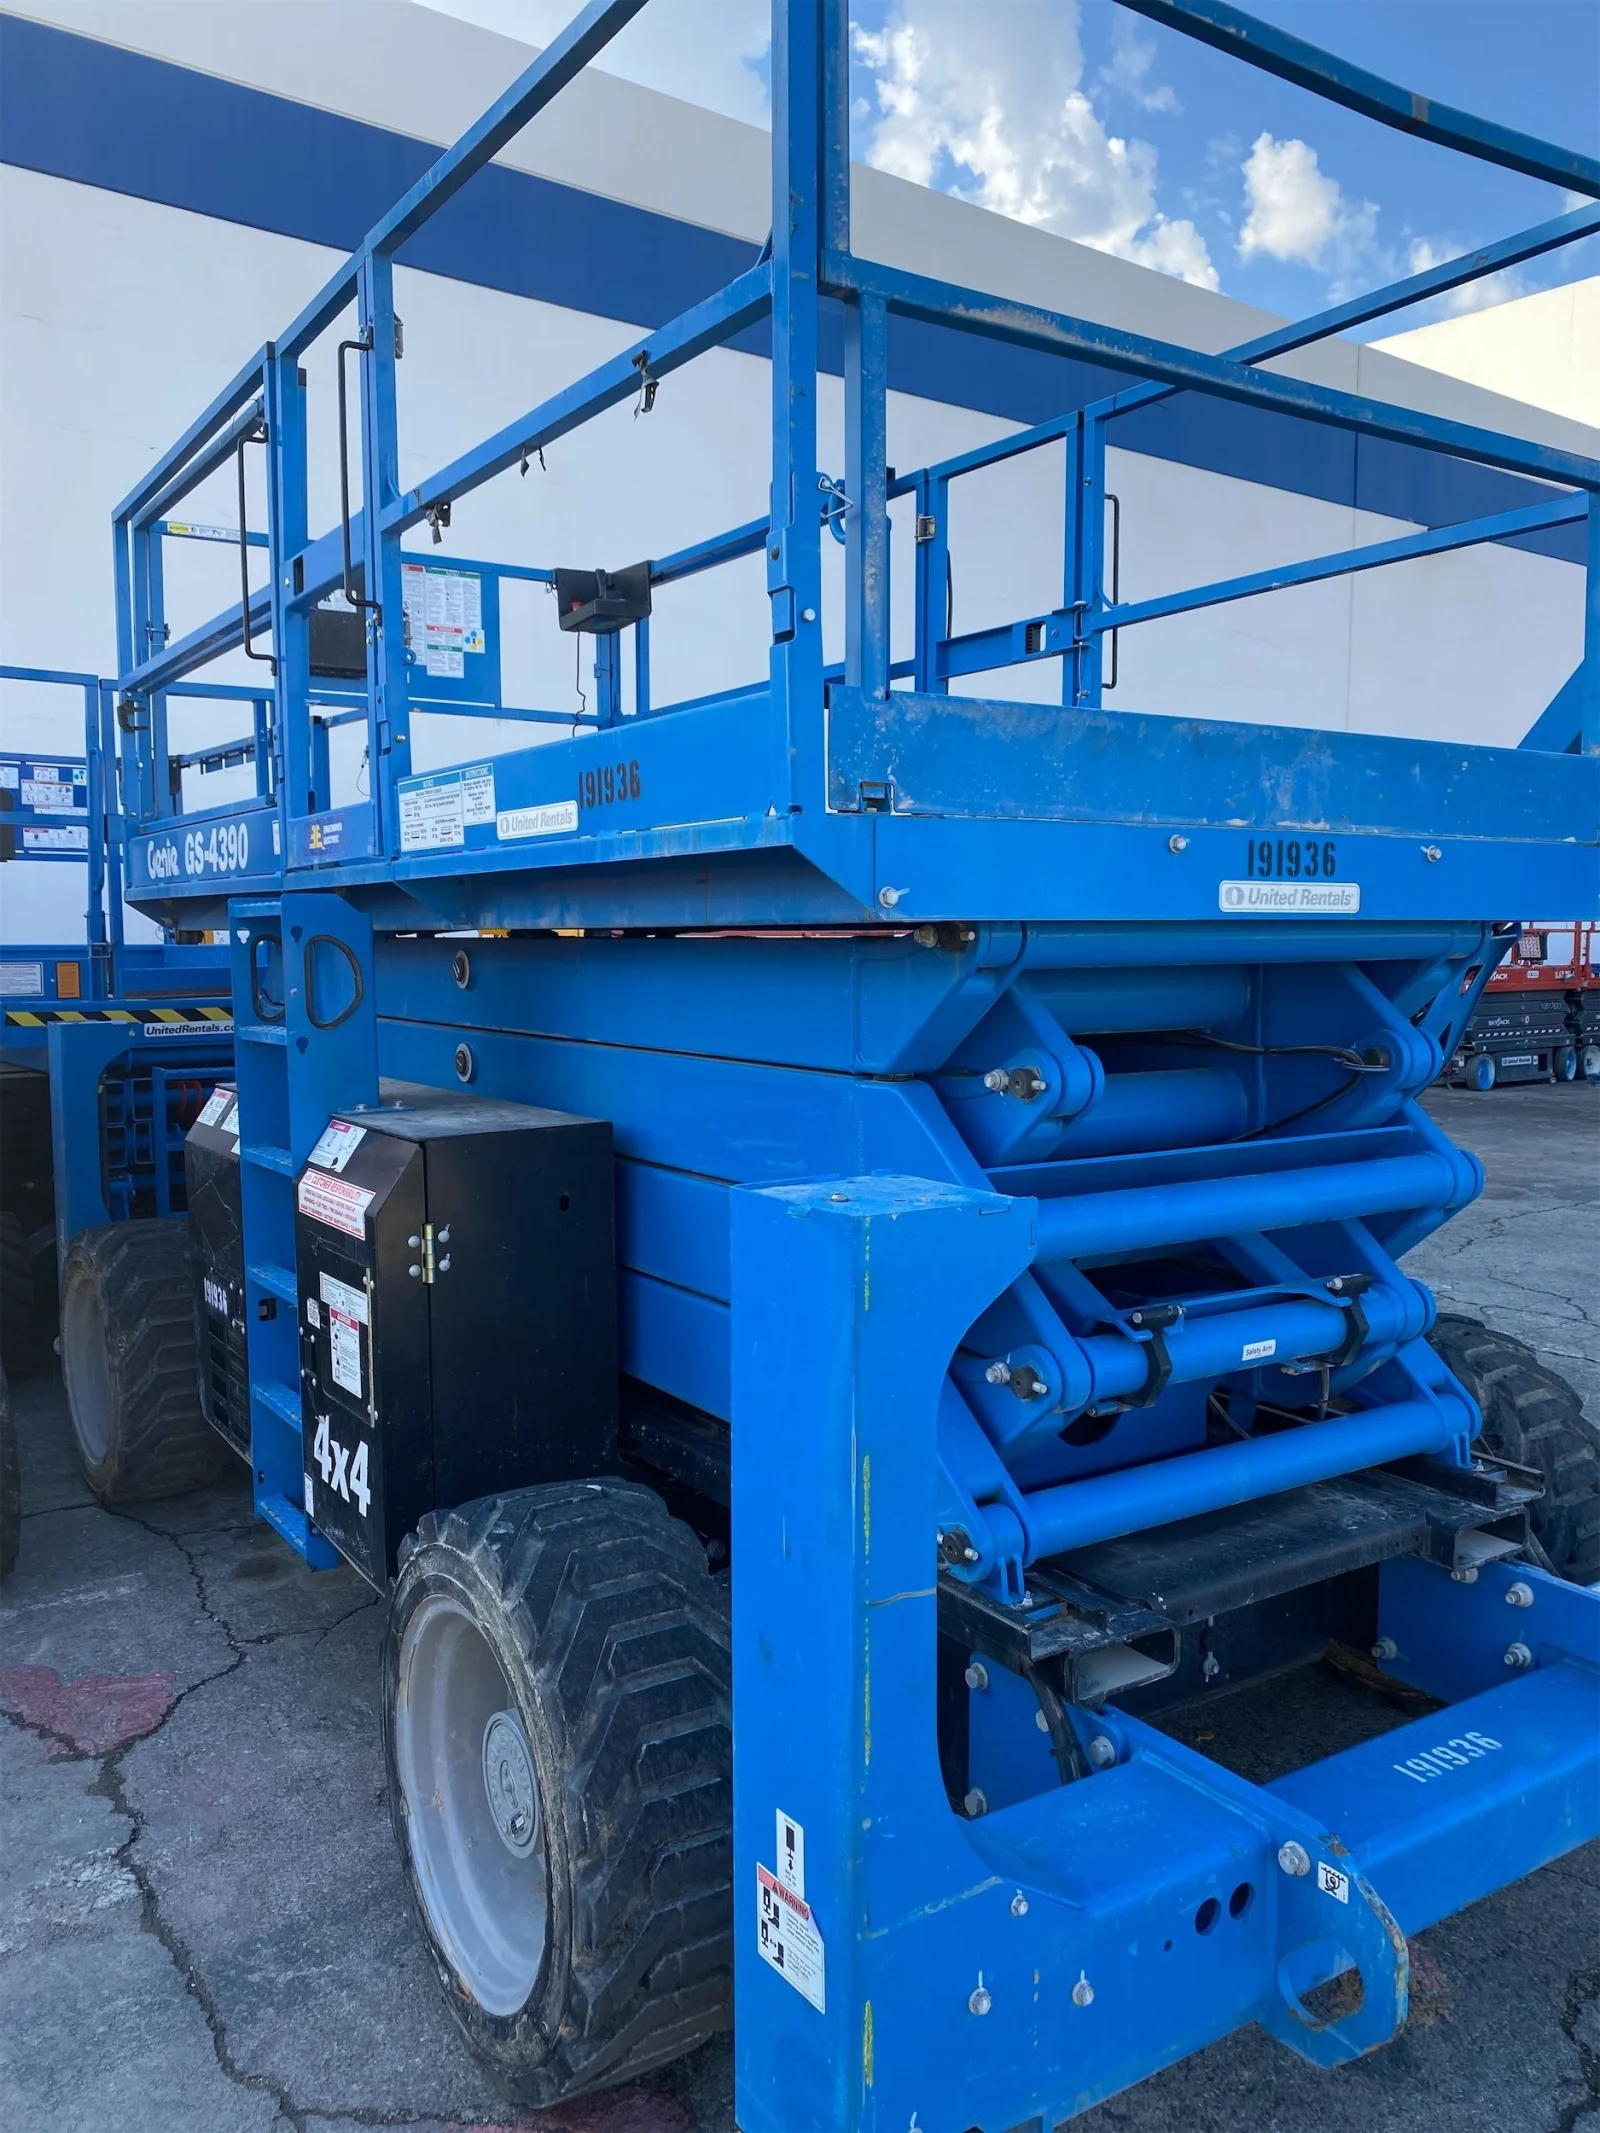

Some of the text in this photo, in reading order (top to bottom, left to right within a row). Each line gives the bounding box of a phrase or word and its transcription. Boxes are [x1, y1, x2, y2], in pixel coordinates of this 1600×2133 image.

[579, 759, 640, 809] 191936
[511, 807, 572, 832] United Rentals
[147, 822, 249, 879] Genie GS-4390
[1248, 839, 1336, 877] 191936
[1248, 887, 1351, 907] United Rentals
[1488, 1017, 1510, 1026] SKYJACK
[311, 1175, 332, 1190] CUSTOMER
[204, 1276, 228, 1316] 191936
[1246, 1347, 1261, 1356] Safety
[314, 1415, 370, 1518] 4x4
[1392, 1731, 1502, 1783] 191936
[778, 1884, 810, 1921] WARNING
